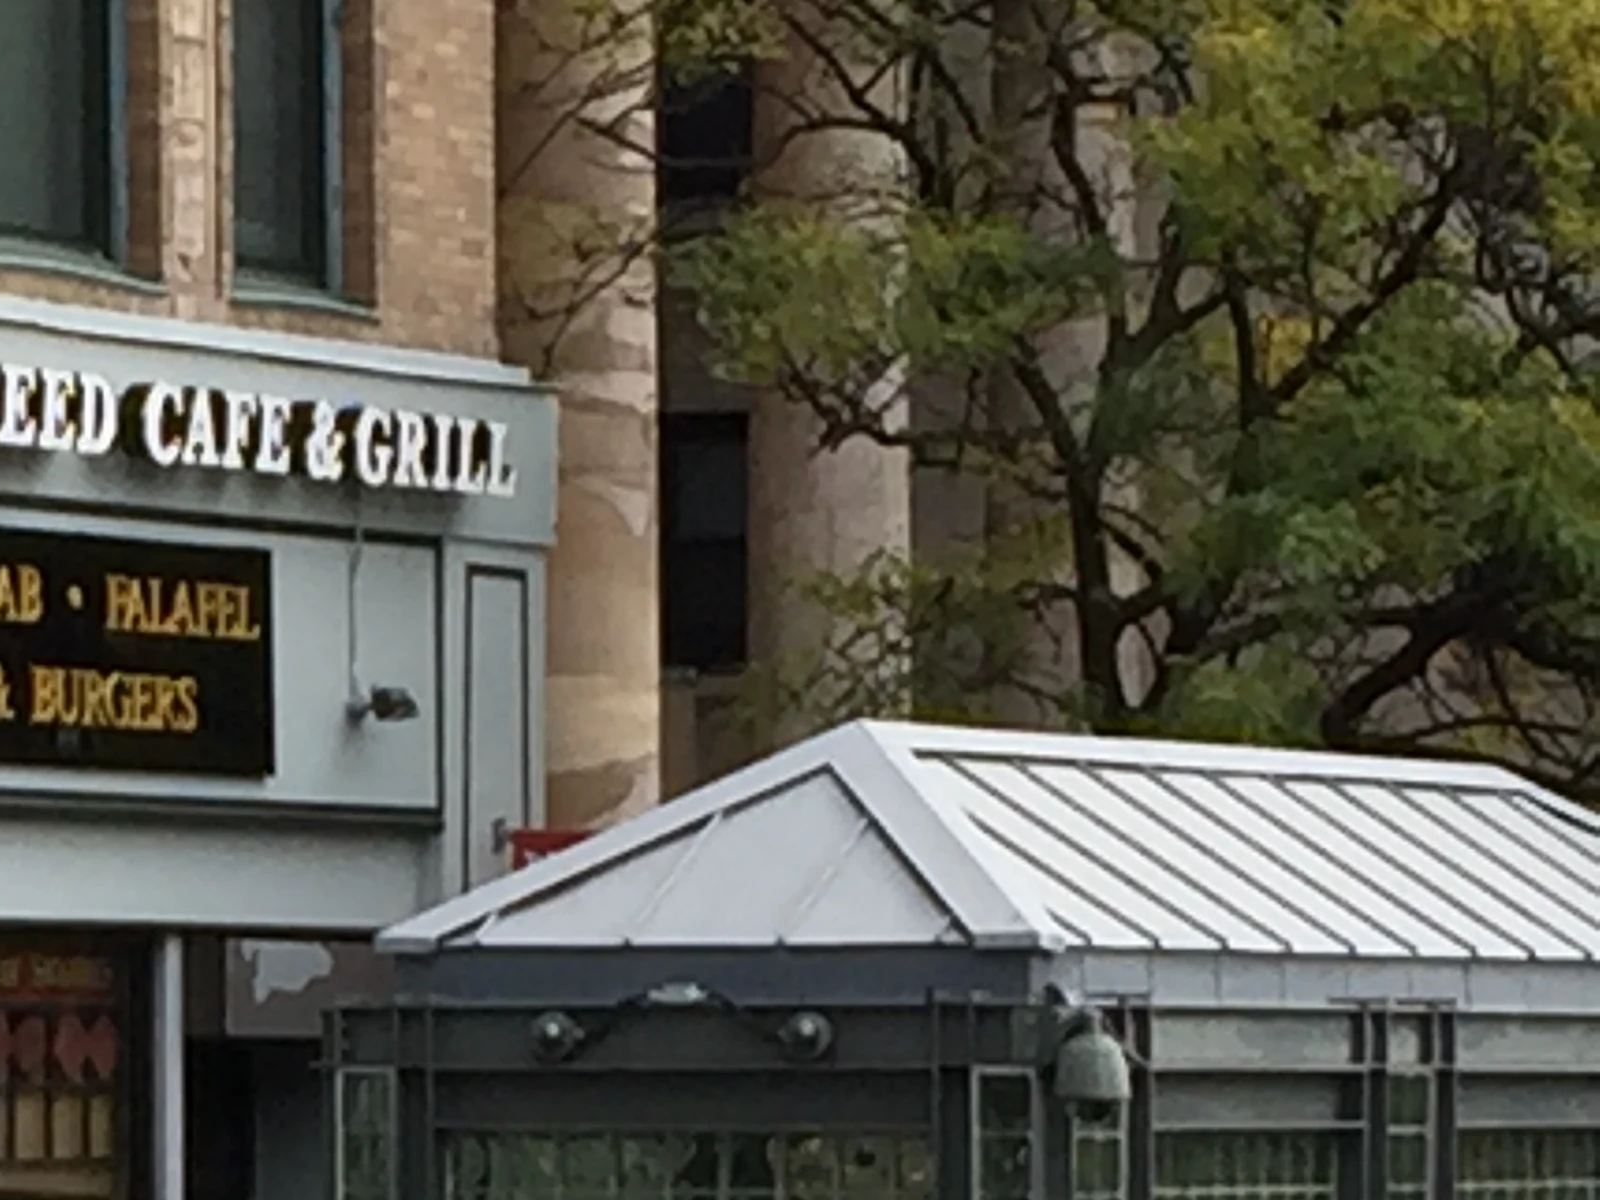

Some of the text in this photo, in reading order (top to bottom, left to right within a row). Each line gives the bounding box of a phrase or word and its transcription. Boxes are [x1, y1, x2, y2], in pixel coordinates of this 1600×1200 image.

[141, 380, 292, 475] CAFE
[306, 398, 347, 483] &
[354, 405, 520, 498] GRILL
[104, 571, 261, 641] FALAFEL
[28, 663, 199, 733] BURGERS
